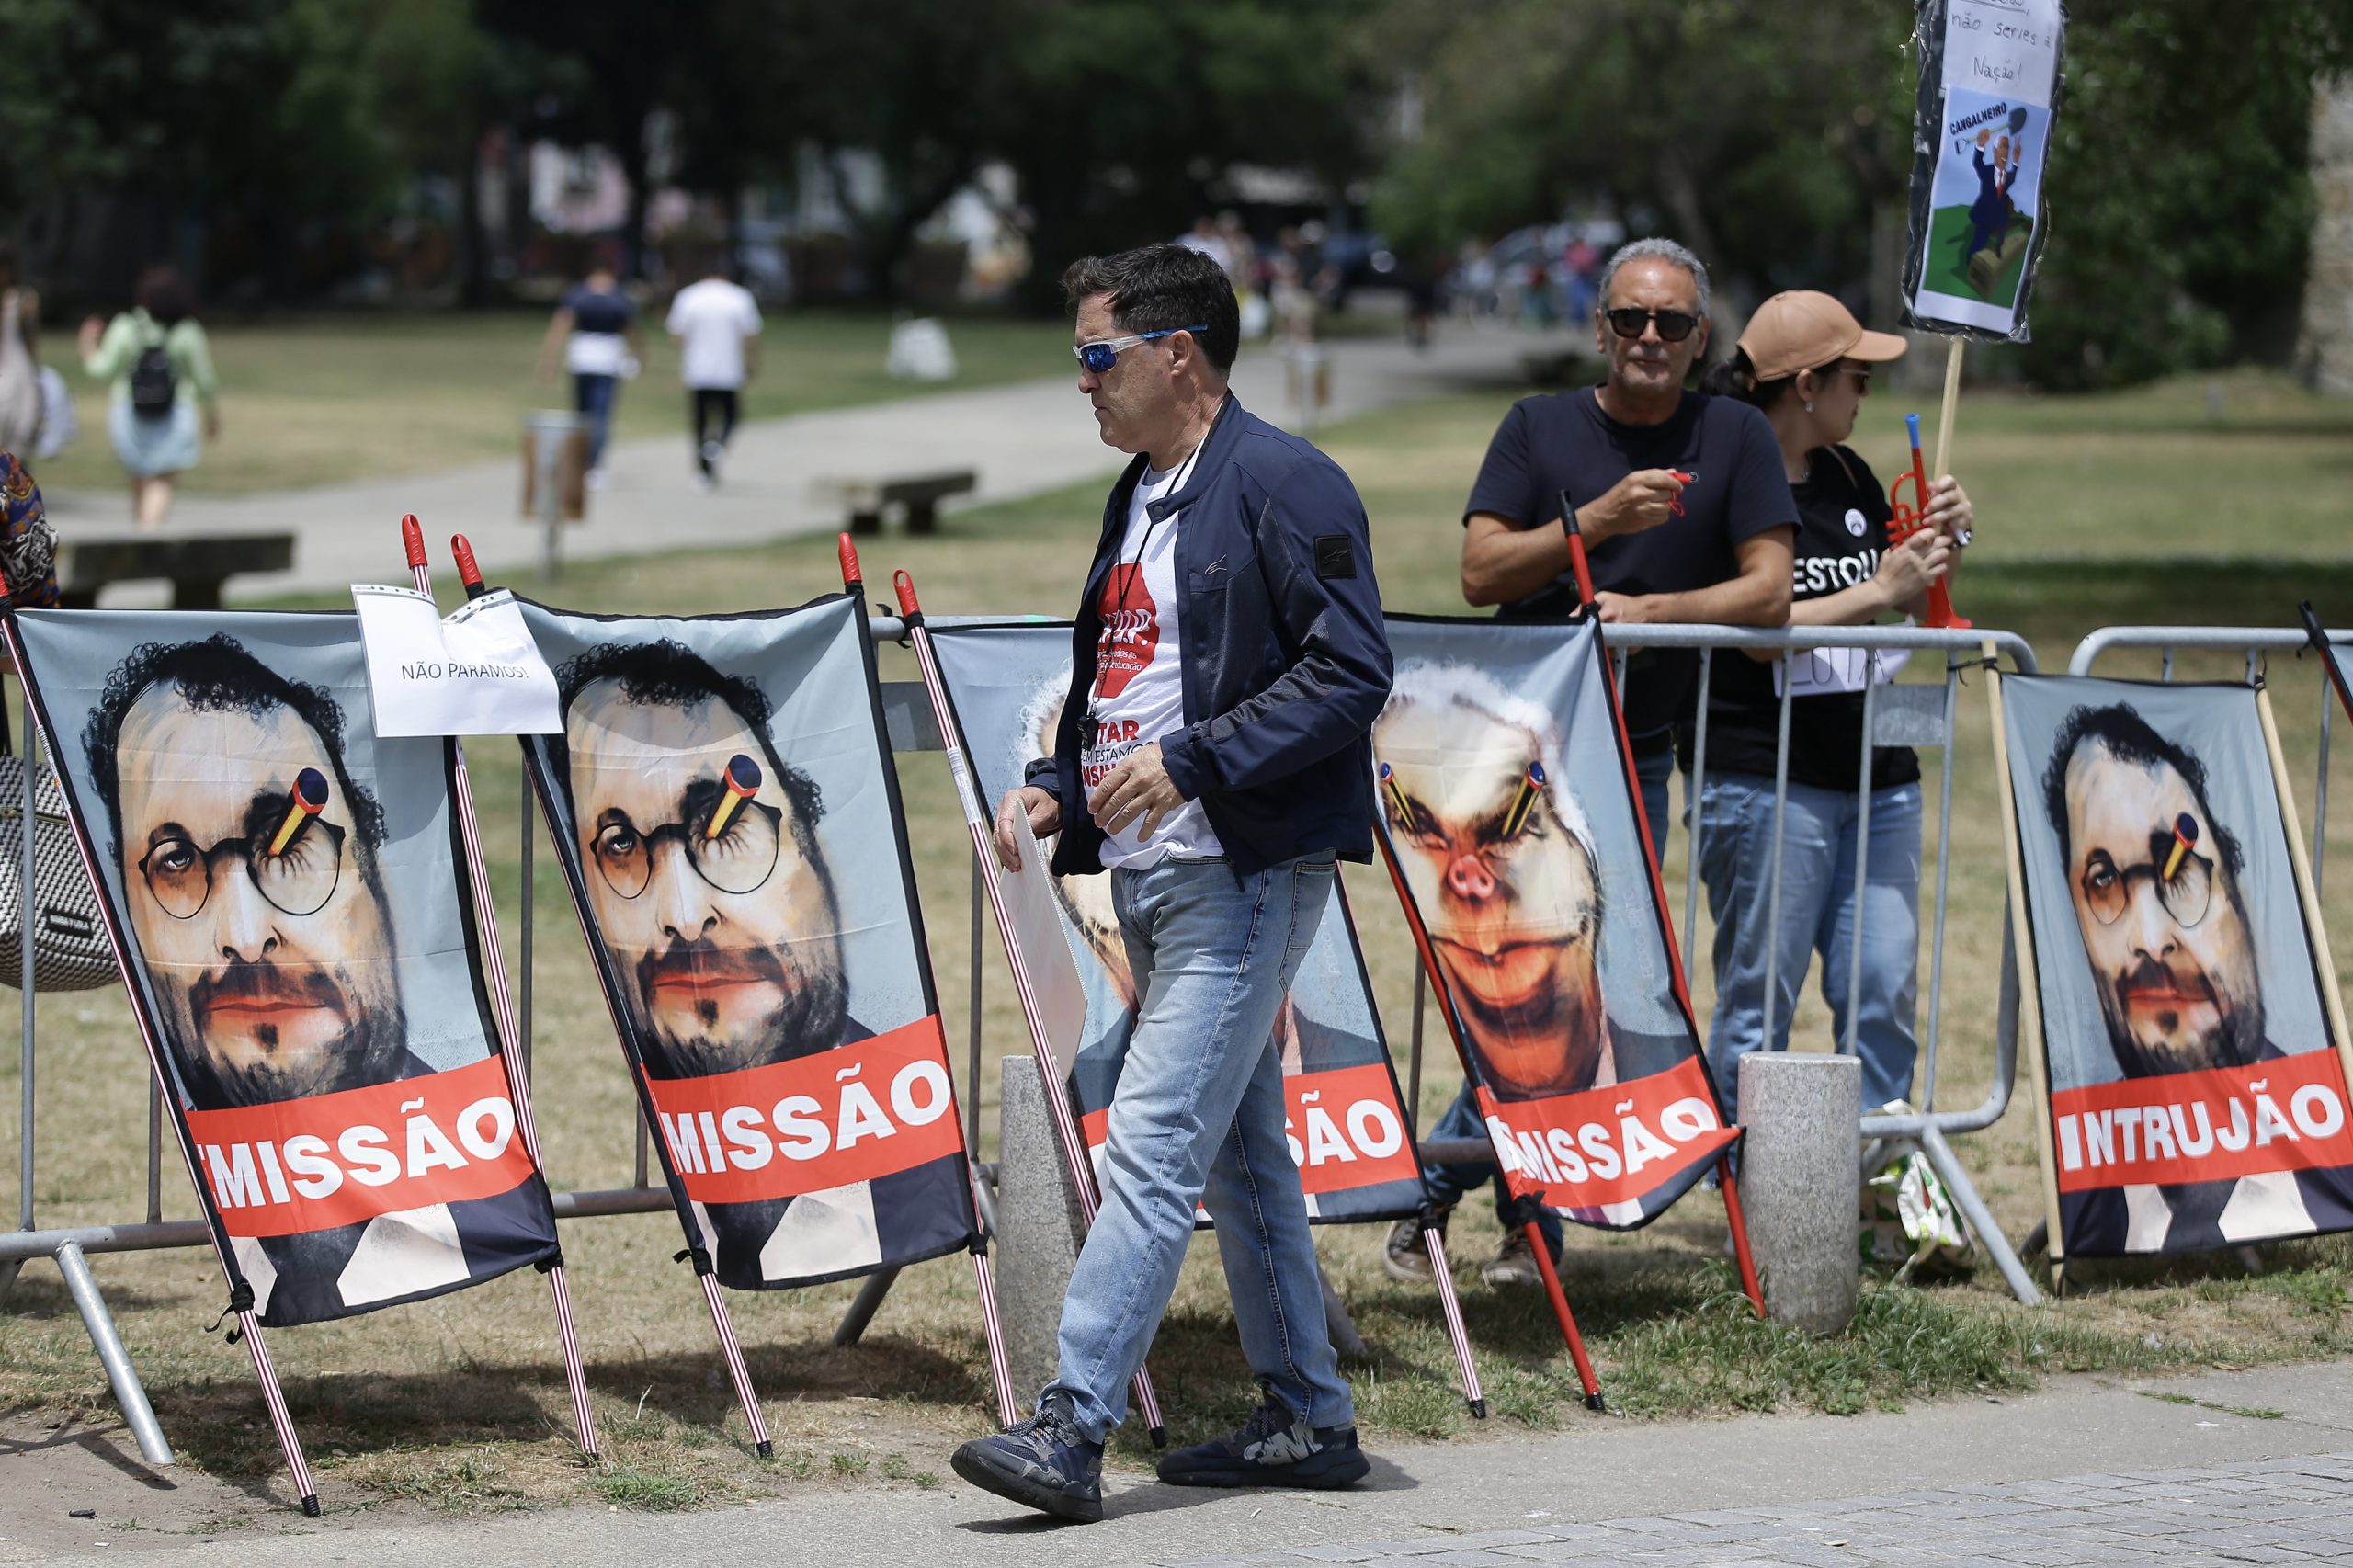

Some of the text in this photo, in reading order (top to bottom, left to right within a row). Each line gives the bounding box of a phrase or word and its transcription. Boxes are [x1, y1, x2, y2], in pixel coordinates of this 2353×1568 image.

[1951, 11, 1981, 30] não
[1993, 22, 2036, 45] serves
[1973, 56, 2022, 87] Nação!
[402, 661, 529, 680] NÃO PARAMOS!
[1097, 720, 1140, 744] TAR
[658, 1060, 952, 1175] MISSÃO
[2057, 1077, 2345, 1172] INTRUJÃO
[202, 1096, 516, 1210] MISSÃO
